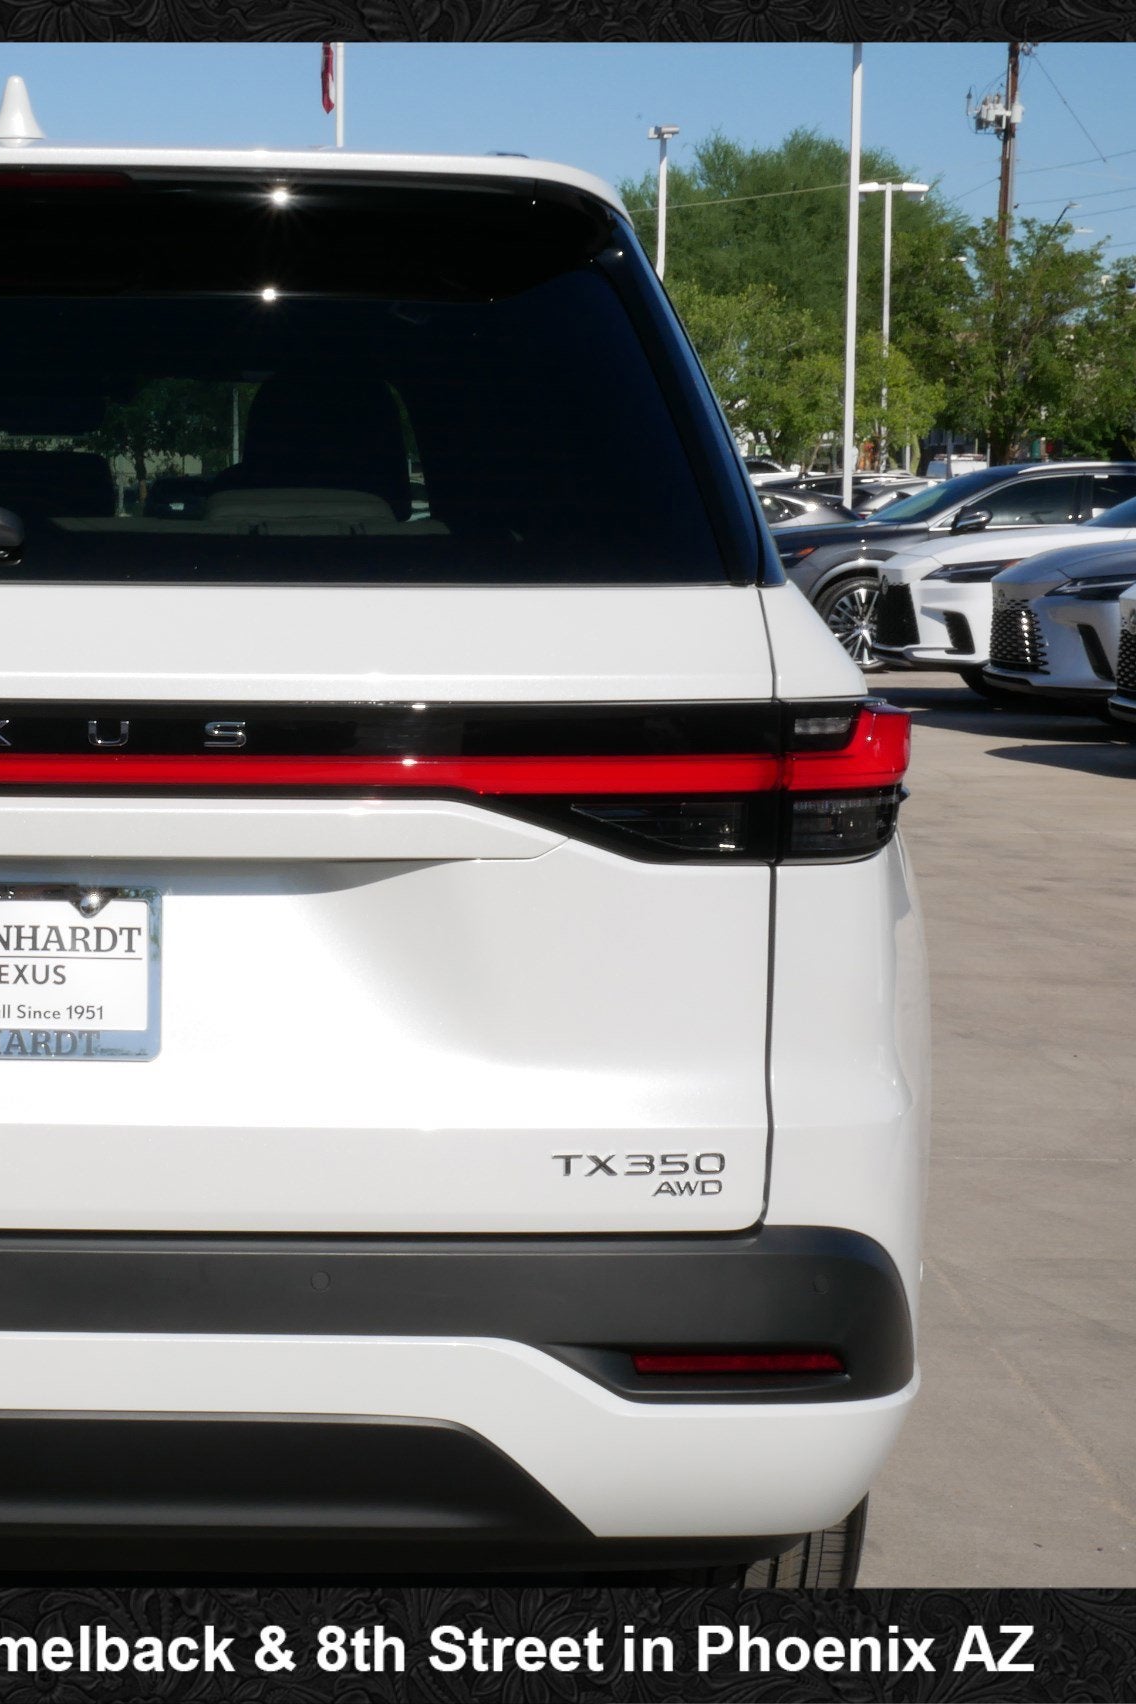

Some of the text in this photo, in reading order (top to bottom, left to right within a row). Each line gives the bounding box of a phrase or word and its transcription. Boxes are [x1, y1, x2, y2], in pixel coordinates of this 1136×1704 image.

[17, 1004, 61, 1020] Since
[66, 1005, 104, 1020] 1951
[551, 1152, 726, 1177] TX350
[651, 1179, 723, 1197] AWD
